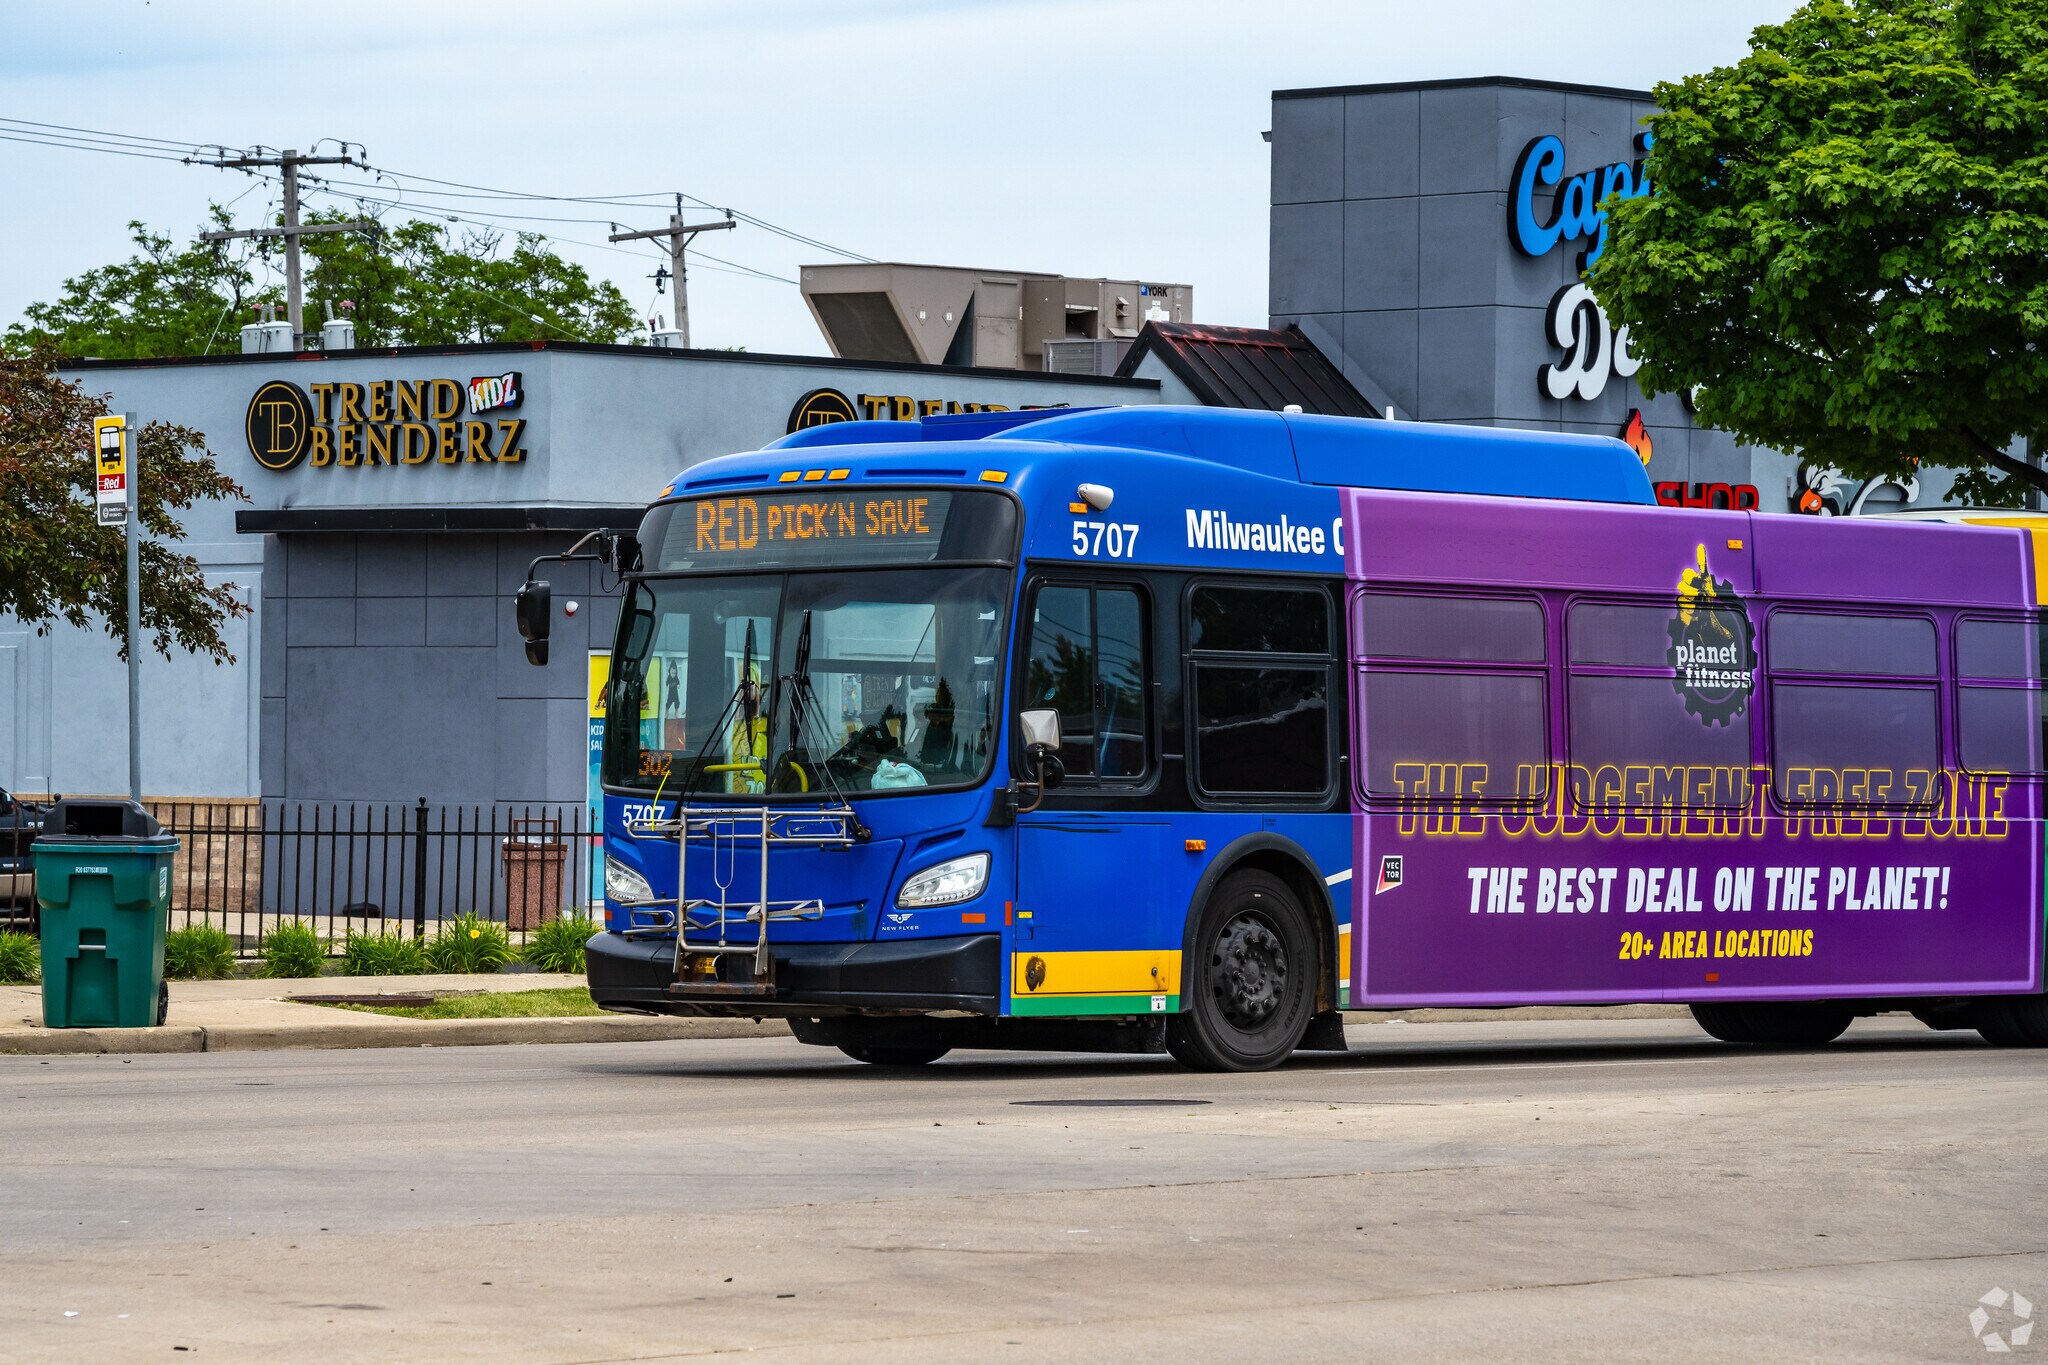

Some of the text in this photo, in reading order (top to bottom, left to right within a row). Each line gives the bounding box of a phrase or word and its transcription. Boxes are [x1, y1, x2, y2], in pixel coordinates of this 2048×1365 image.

[1148, 287, 1167, 297] YORK
[311, 373, 517, 424] TREND KIDZ
[310, 419, 527, 467] BENDERZ
[103, 476, 120, 489] Red
[696, 498, 930, 551] RED PICK'N SAVE
[1072, 521, 1140, 558] 5707
[1186, 508, 1326, 555] Milwaukee
[1676, 639, 1737, 670] planet
[1685, 664, 1752, 689] fitness
[639, 751, 673, 776] 302
[622, 804, 666, 828] 5707
[1394, 763, 2011, 838] THE JUDGEMENT FREE ZONE
[1468, 866, 1951, 914] THE BEST DEAL ON THE PLANET!
[1618, 928, 1814, 960] 20+ AREA LOCATIONS
